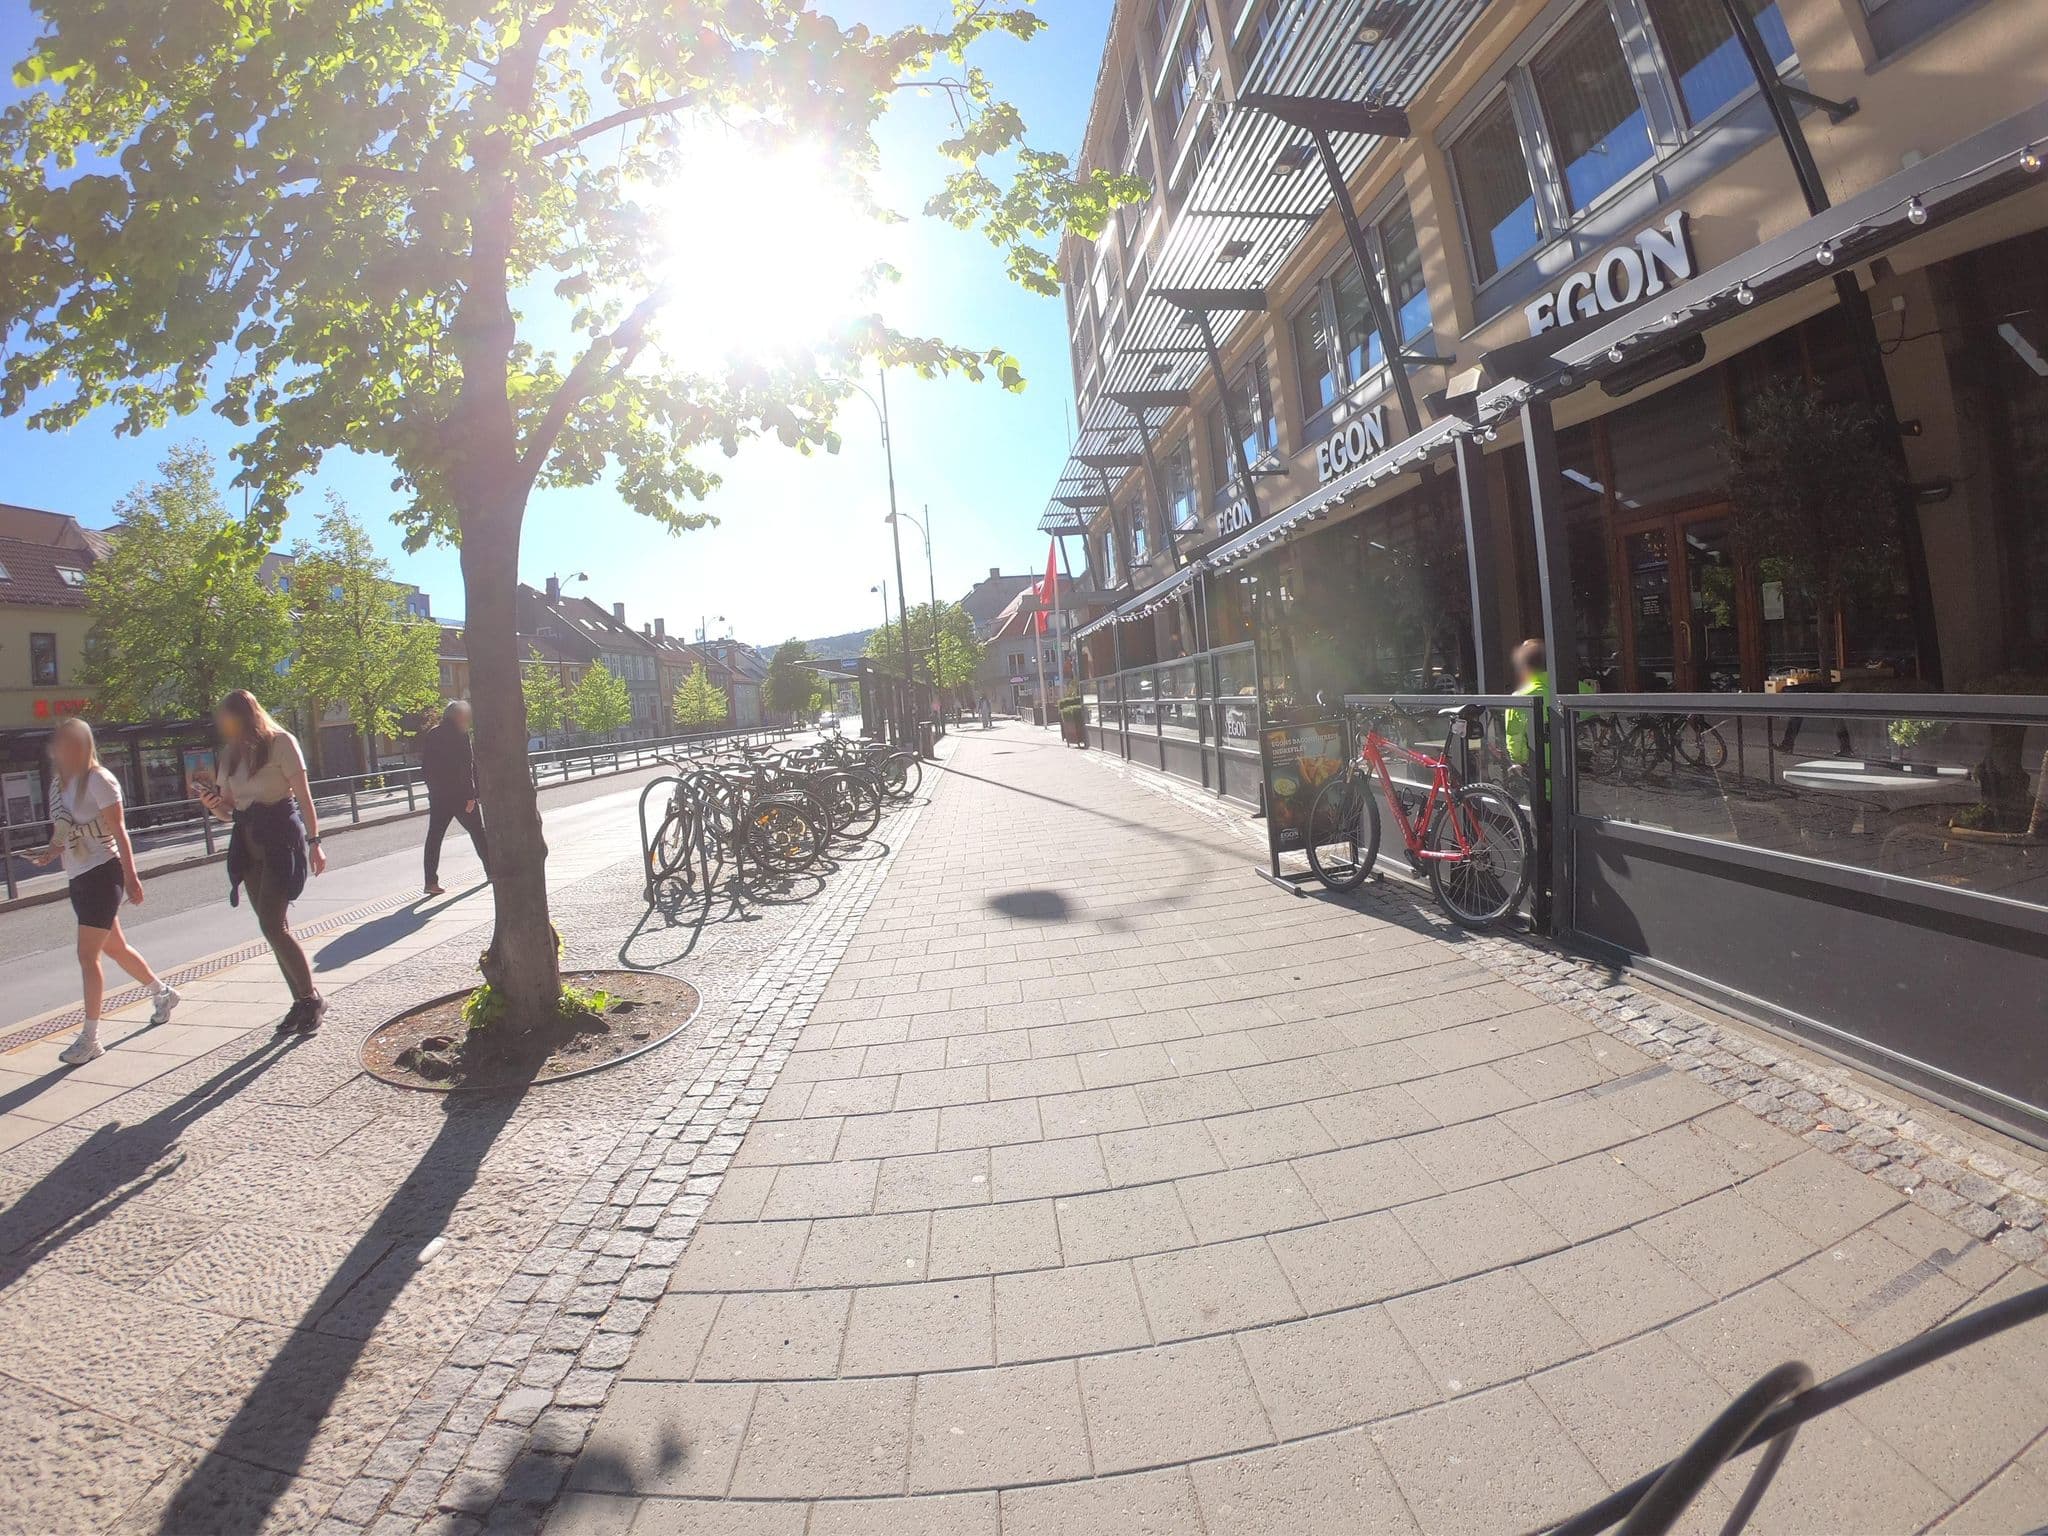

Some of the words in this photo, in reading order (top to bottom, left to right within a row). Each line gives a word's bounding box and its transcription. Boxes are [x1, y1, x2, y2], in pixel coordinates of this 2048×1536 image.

[1524, 209, 1690, 337] EGON
[1315, 405, 1386, 483] EGON
[1216, 498, 1253, 538] EGON
[1228, 720, 1247, 737] EGON
